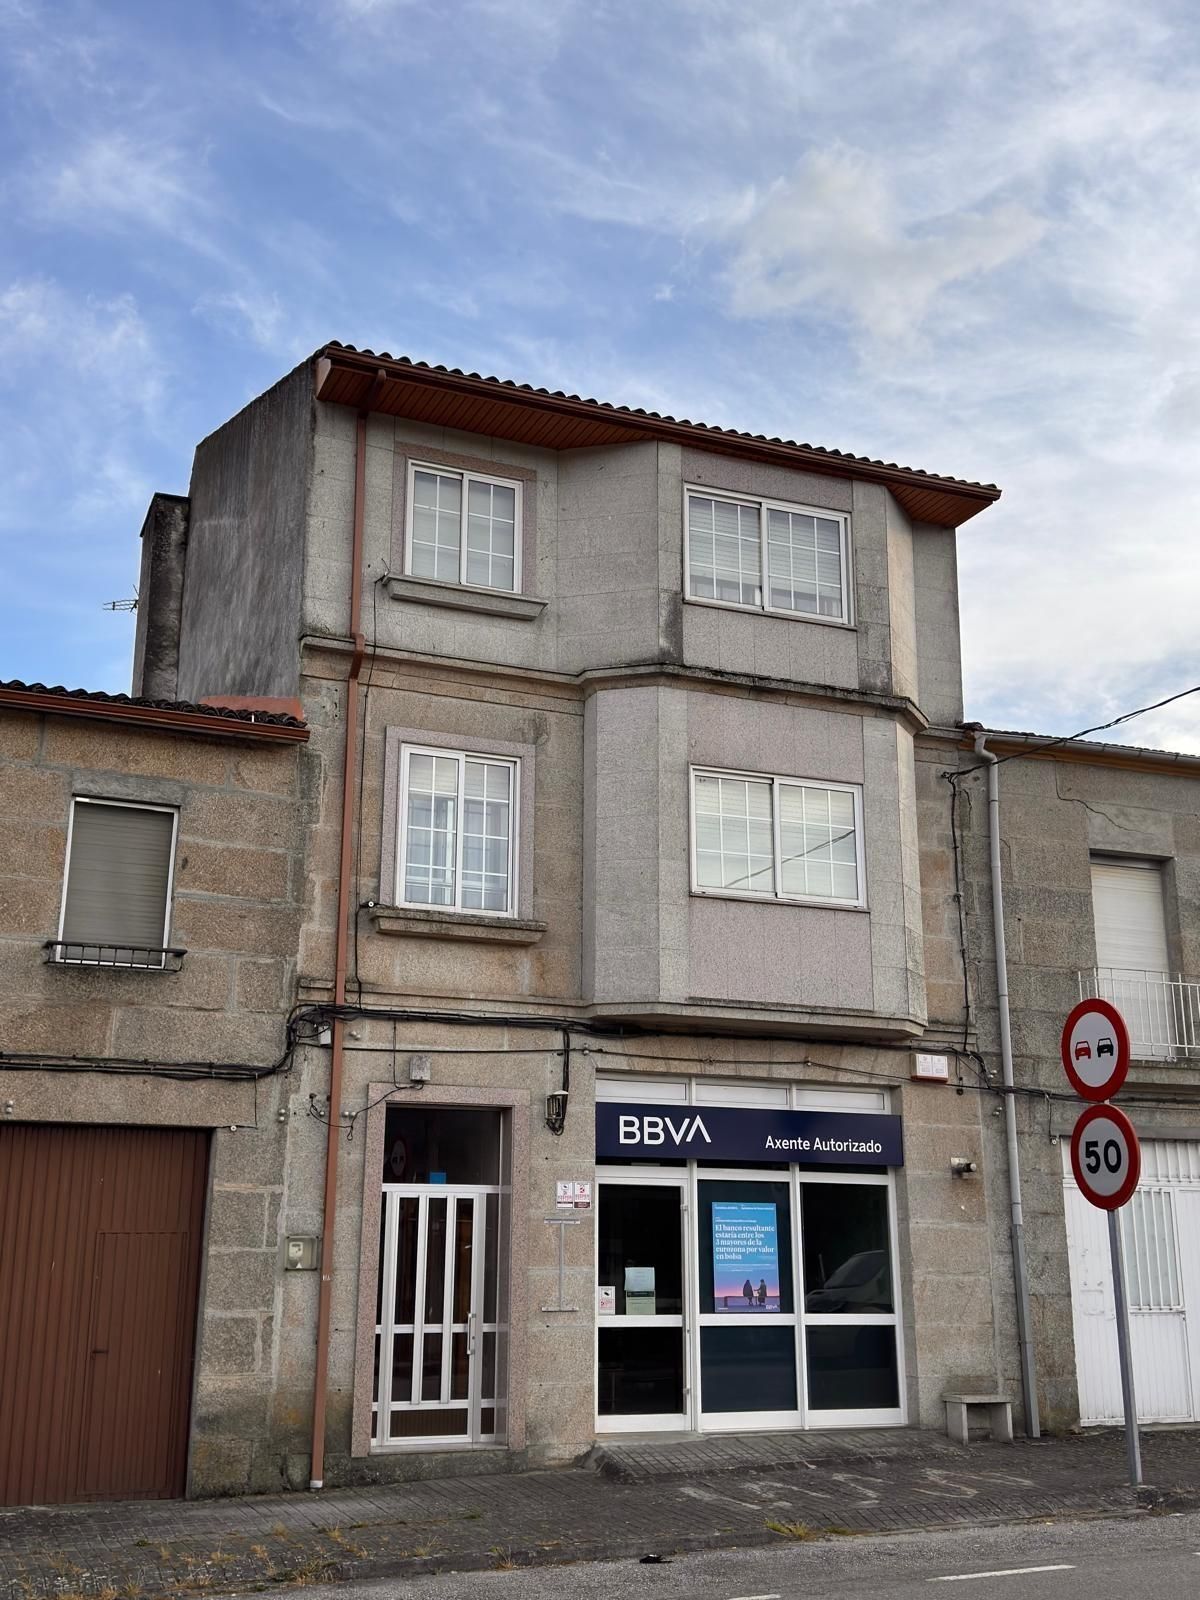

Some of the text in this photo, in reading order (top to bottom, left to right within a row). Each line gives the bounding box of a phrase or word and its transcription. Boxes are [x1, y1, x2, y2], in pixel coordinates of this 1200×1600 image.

[619, 1114, 711, 1145] BBVA
[765, 1135, 882, 1153] Axente Autorizado
[1085, 1139, 1122, 1174] 50
[743, 1224, 775, 1232] resultante
[755, 1231, 765, 1239] los
[720, 1239, 747, 1247] mayores
[758, 1245, 775, 1253] valor
[725, 1252, 742, 1260] bolsa
